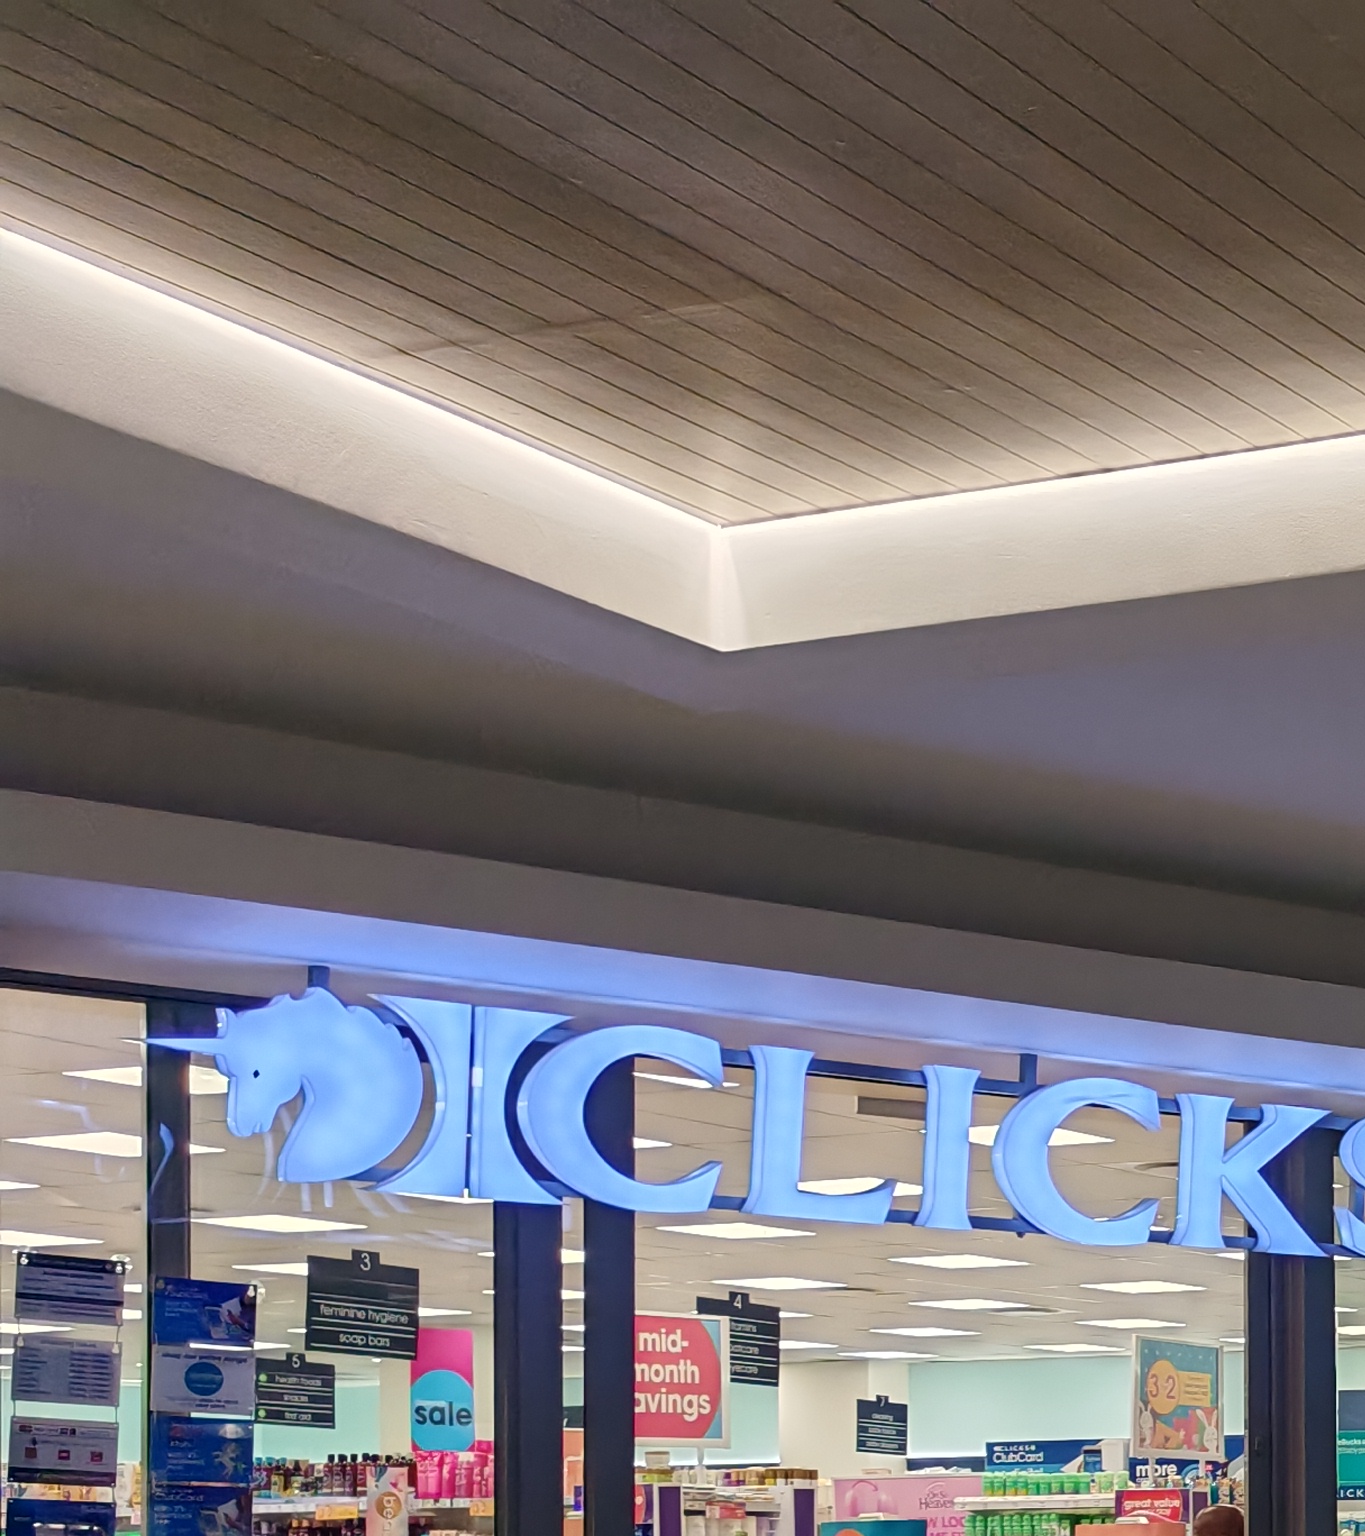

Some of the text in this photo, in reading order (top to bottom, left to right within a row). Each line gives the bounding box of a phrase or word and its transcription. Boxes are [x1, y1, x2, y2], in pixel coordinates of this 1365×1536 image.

[360, 1253, 371, 1271] 3
[733, 1294, 742, 1309] 4
[320, 1304, 409, 1325] feminine hygiene
[339, 1333, 390, 1347] soap bars
[638, 1328, 689, 1353] mid-
[1149, 1373, 1159, 1398] 3
[1165, 1374, 1176, 1399] 2
[414, 1398, 473, 1430] sale
[992, 1451, 1044, 1464] ClubCard
[1136, 1463, 1178, 1478] more
[1153, 1498, 1180, 1509] value
